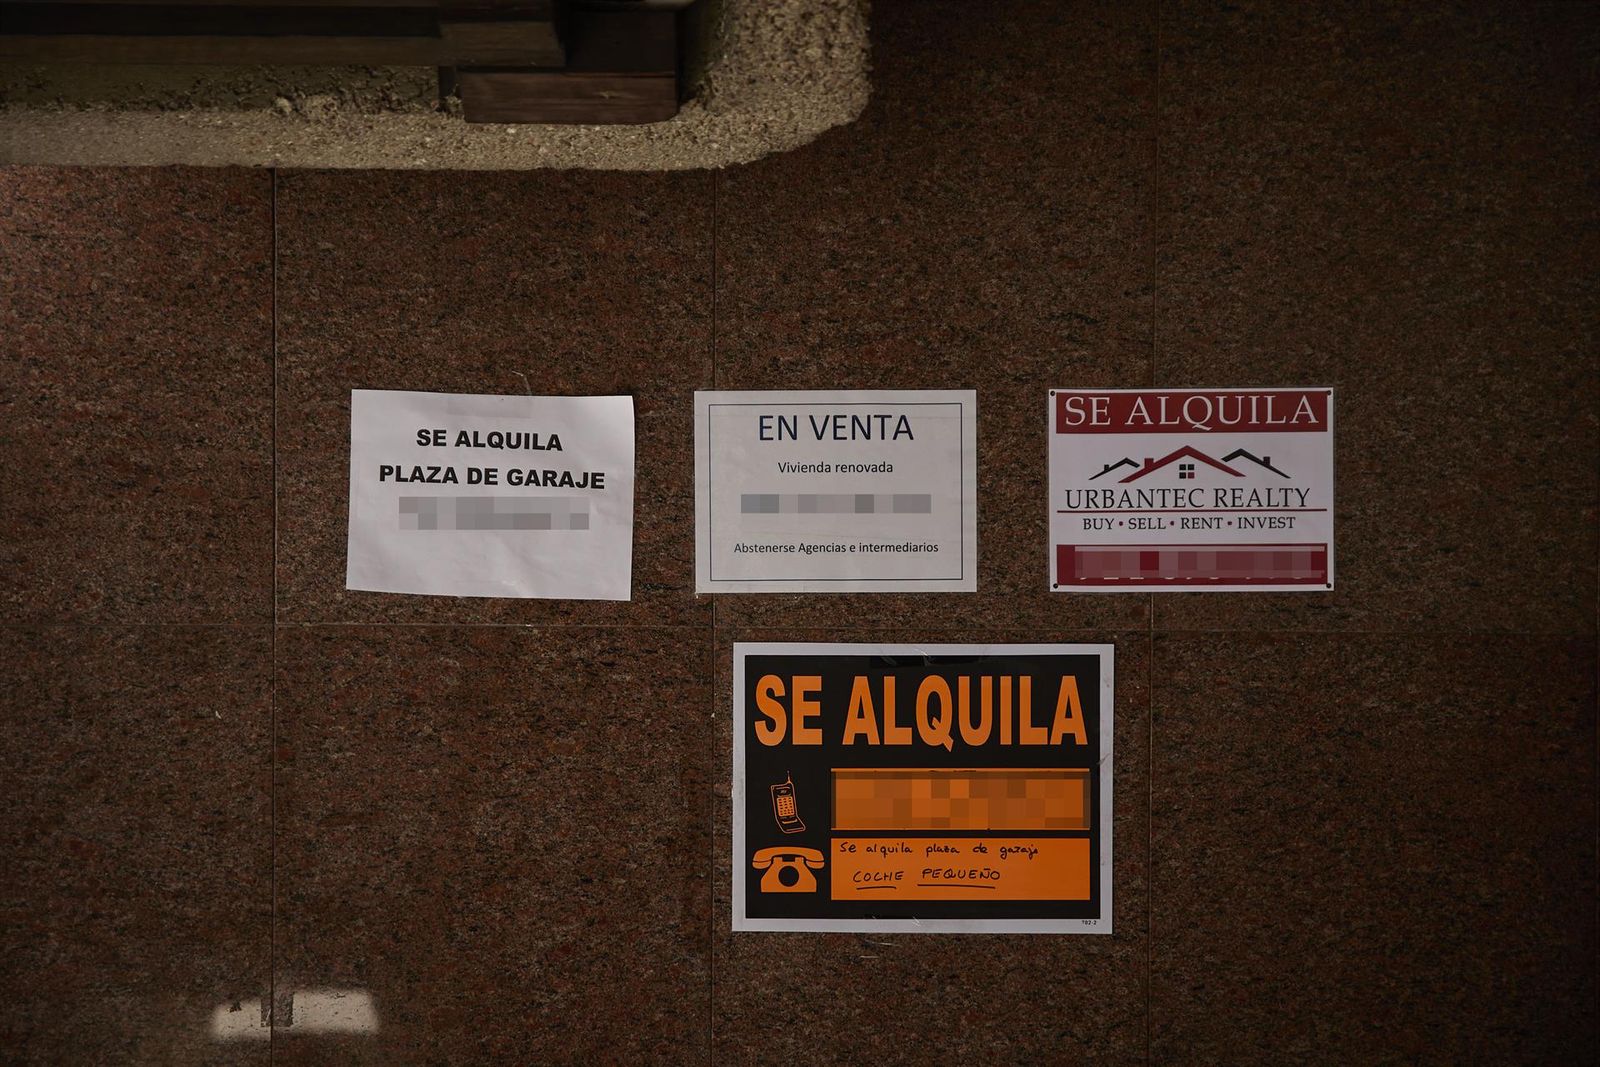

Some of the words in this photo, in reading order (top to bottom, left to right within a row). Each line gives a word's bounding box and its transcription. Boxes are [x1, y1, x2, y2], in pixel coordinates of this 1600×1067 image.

[1065, 396, 1111, 426] SE
[1124, 395, 1319, 431] ALQUILA
[758, 414, 798, 441] EN
[808, 414, 914, 441] VENTA
[416, 428, 447, 447] SE
[454, 430, 563, 452] ALQUILA
[379, 464, 459, 485] PLAZA
[466, 467, 499, 486] DE
[506, 468, 605, 490] GARAJE
[777, 461, 832, 474] Vivienda
[835, 461, 894, 474] renovada
[1065, 488, 1205, 509] URBANTEC
[1213, 487, 1311, 508] REALTY
[1082, 517, 1115, 530] BUY
[1128, 517, 1167, 530] SELL
[1180, 517, 1224, 530] RENT
[1237, 516, 1296, 530] INVEST
[733, 542, 796, 554] Abstenerse
[797, 542, 847, 555] Agencias
[849, 544, 856, 553] e
[858, 541, 939, 554] intermediarios
[754, 674, 823, 747] SE
[842, 674, 1088, 753] ALQUILA
[865, 843, 913, 859] alquila
[925, 843, 961, 857] plaza
[972, 842, 988, 854] de
[852, 870, 905, 883] COCHE
[921, 867, 1001, 881] PEQUEÑO
